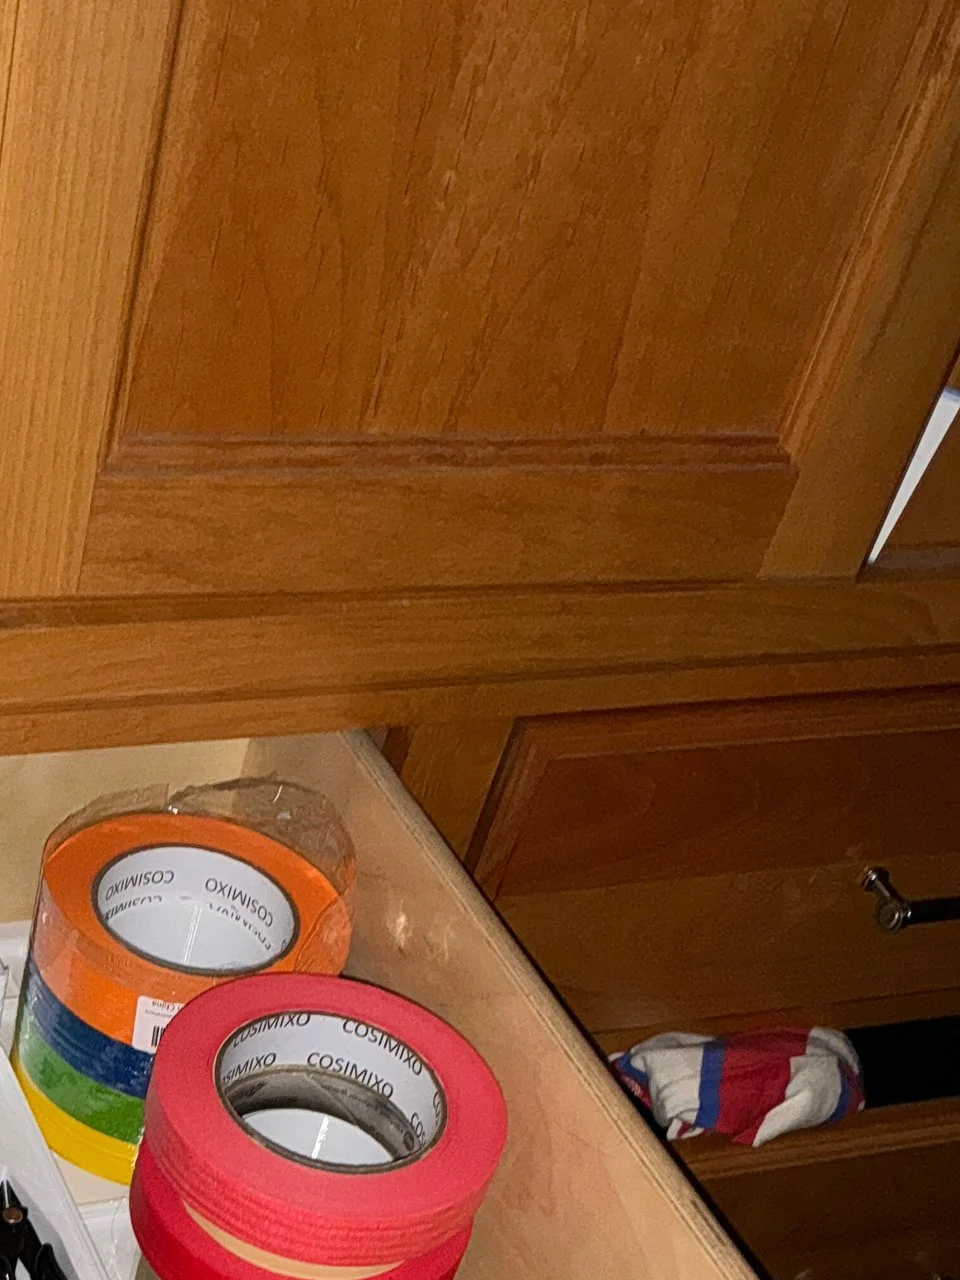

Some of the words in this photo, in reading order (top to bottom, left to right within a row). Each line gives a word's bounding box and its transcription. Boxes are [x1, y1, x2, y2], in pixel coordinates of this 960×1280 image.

[105, 869, 174, 901] COSIMIXO
[205, 877, 273, 928] COSIMIXO
[307, 1051, 394, 1099] COSIMIXO
